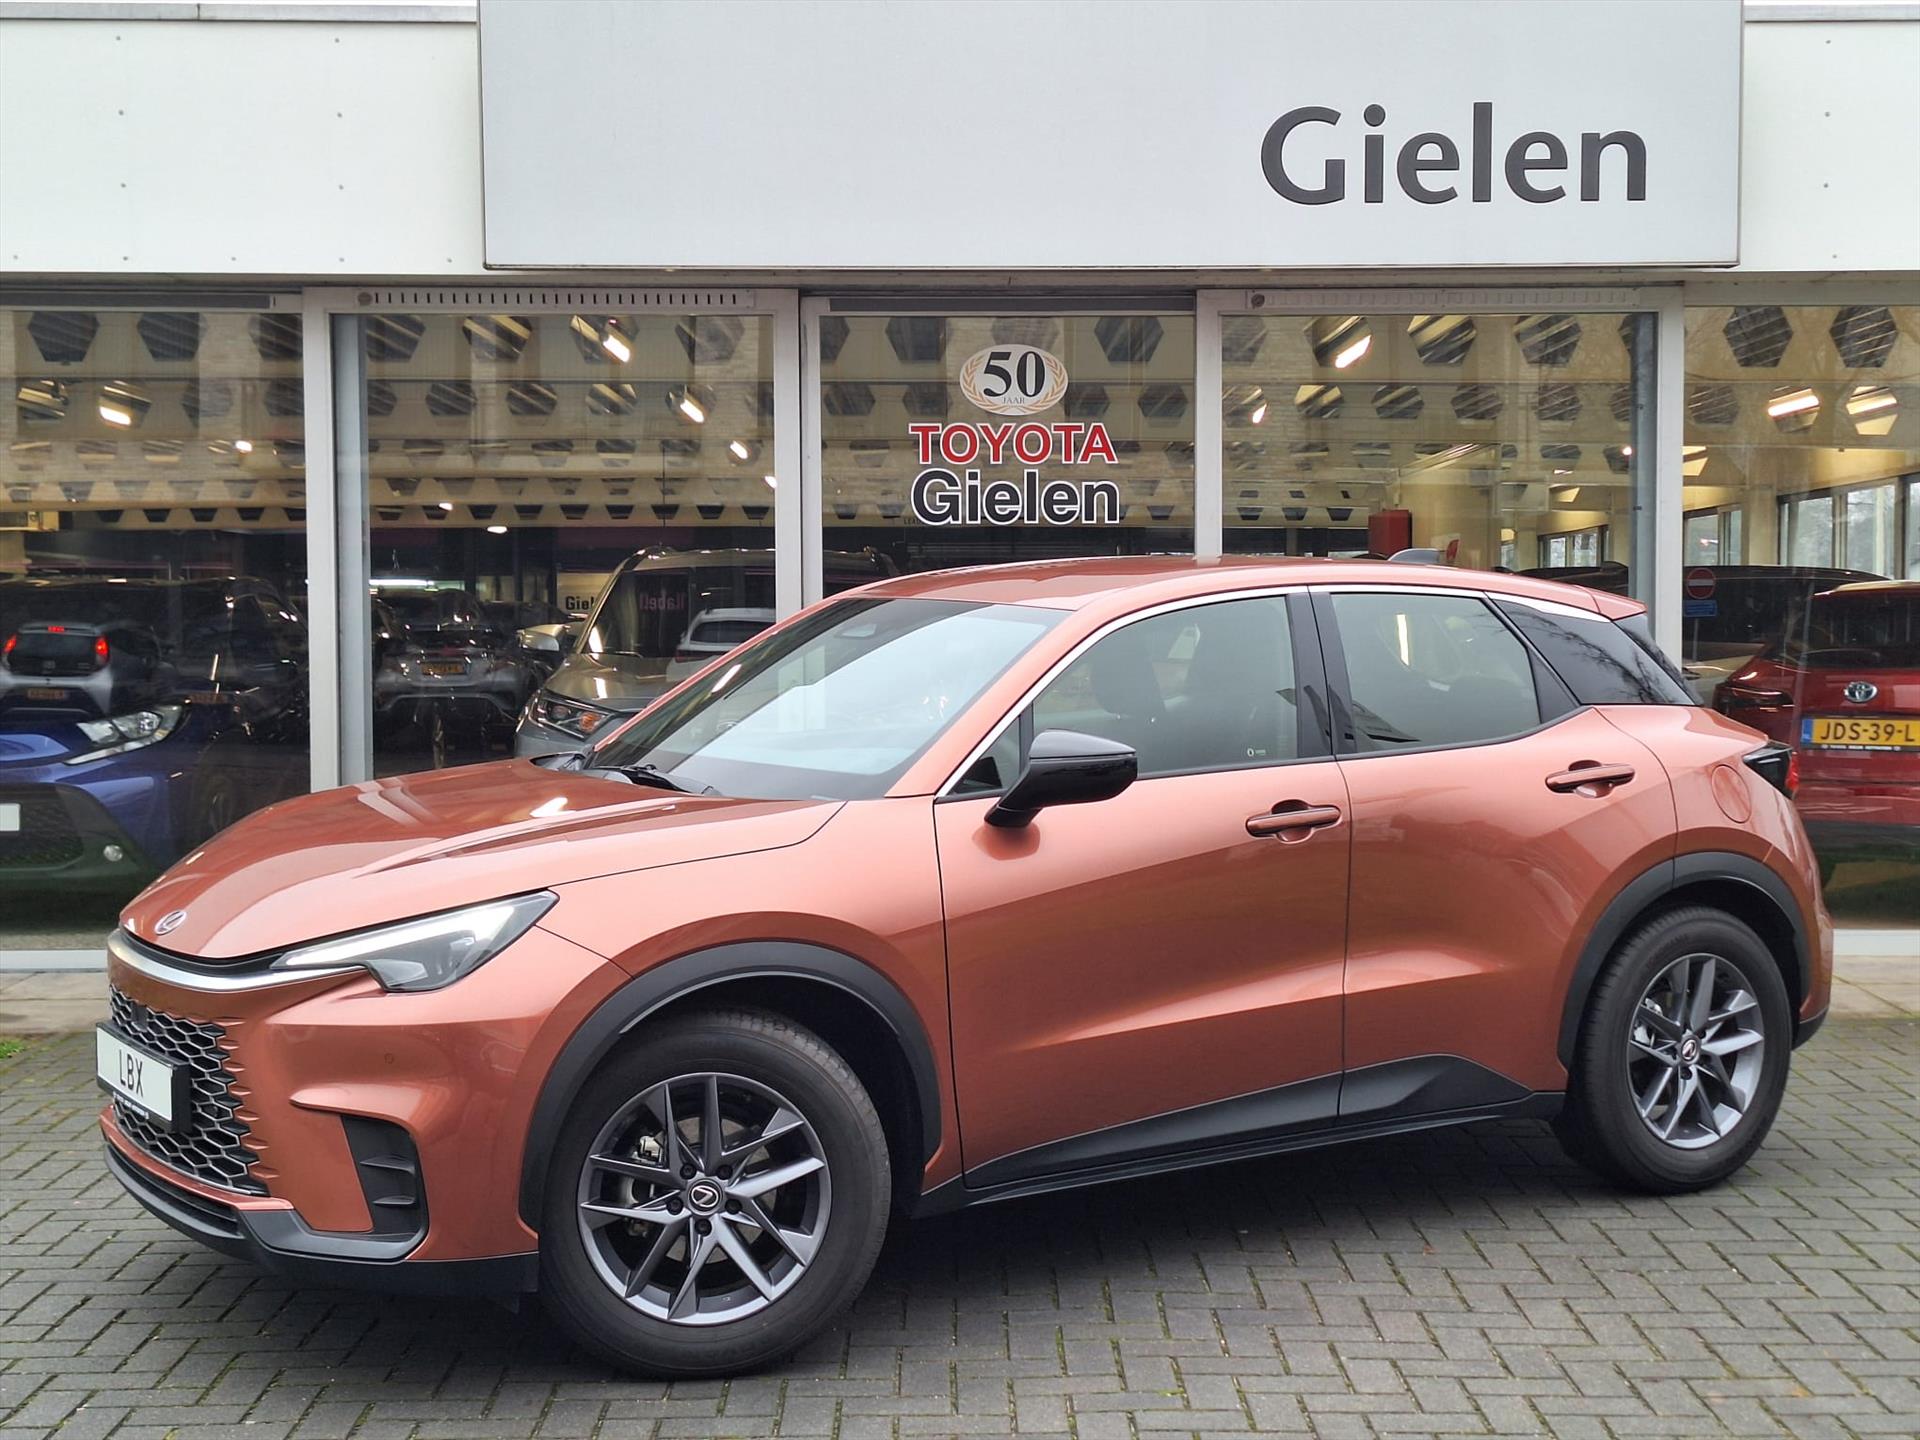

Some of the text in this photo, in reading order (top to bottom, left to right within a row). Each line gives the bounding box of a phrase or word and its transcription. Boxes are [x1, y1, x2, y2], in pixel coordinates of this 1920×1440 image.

[1261, 102, 1647, 205] Gielen
[983, 351, 1045, 397] 50
[1002, 396, 1025, 405] JAAR
[909, 423, 1118, 464] TOYOTA
[911, 468, 1120, 525] Gielen
[1820, 722, 1915, 742] JDS-39-L
[119, 1048, 144, 1098] LBX
